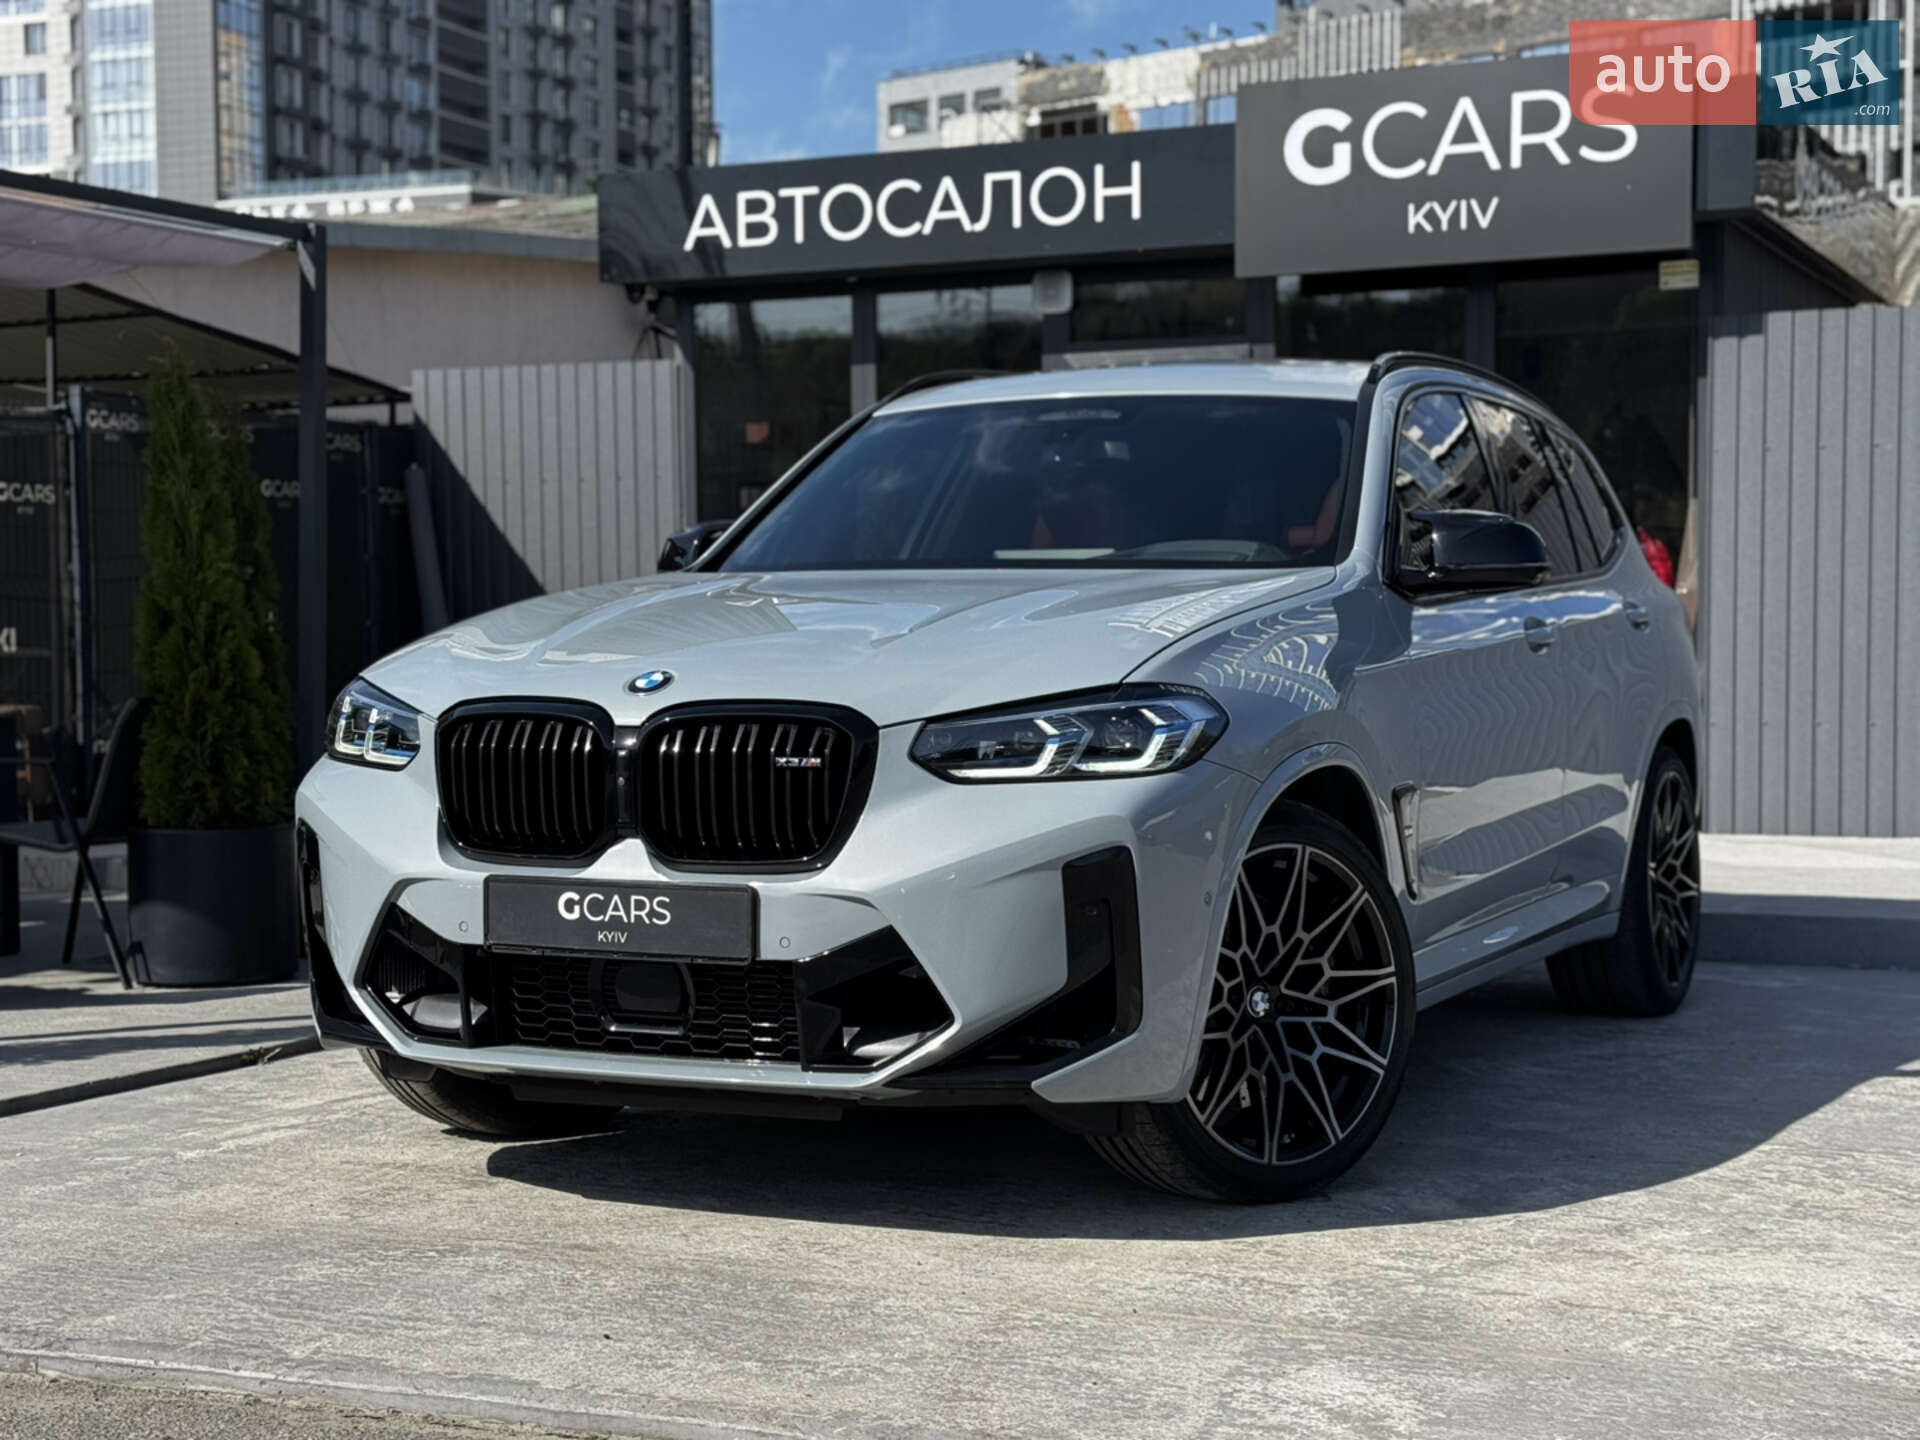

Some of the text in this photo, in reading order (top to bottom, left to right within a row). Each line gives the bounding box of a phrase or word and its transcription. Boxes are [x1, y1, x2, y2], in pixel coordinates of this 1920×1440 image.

[1282, 84, 1639, 186] GCARS
[683, 160, 1142, 252] АВТОСАЛОН
[1408, 197, 1499, 234] KYIV
[260, 478, 300, 499] GCAR
[557, 891, 671, 925] GCARS
[597, 931, 627, 943] KYIV
